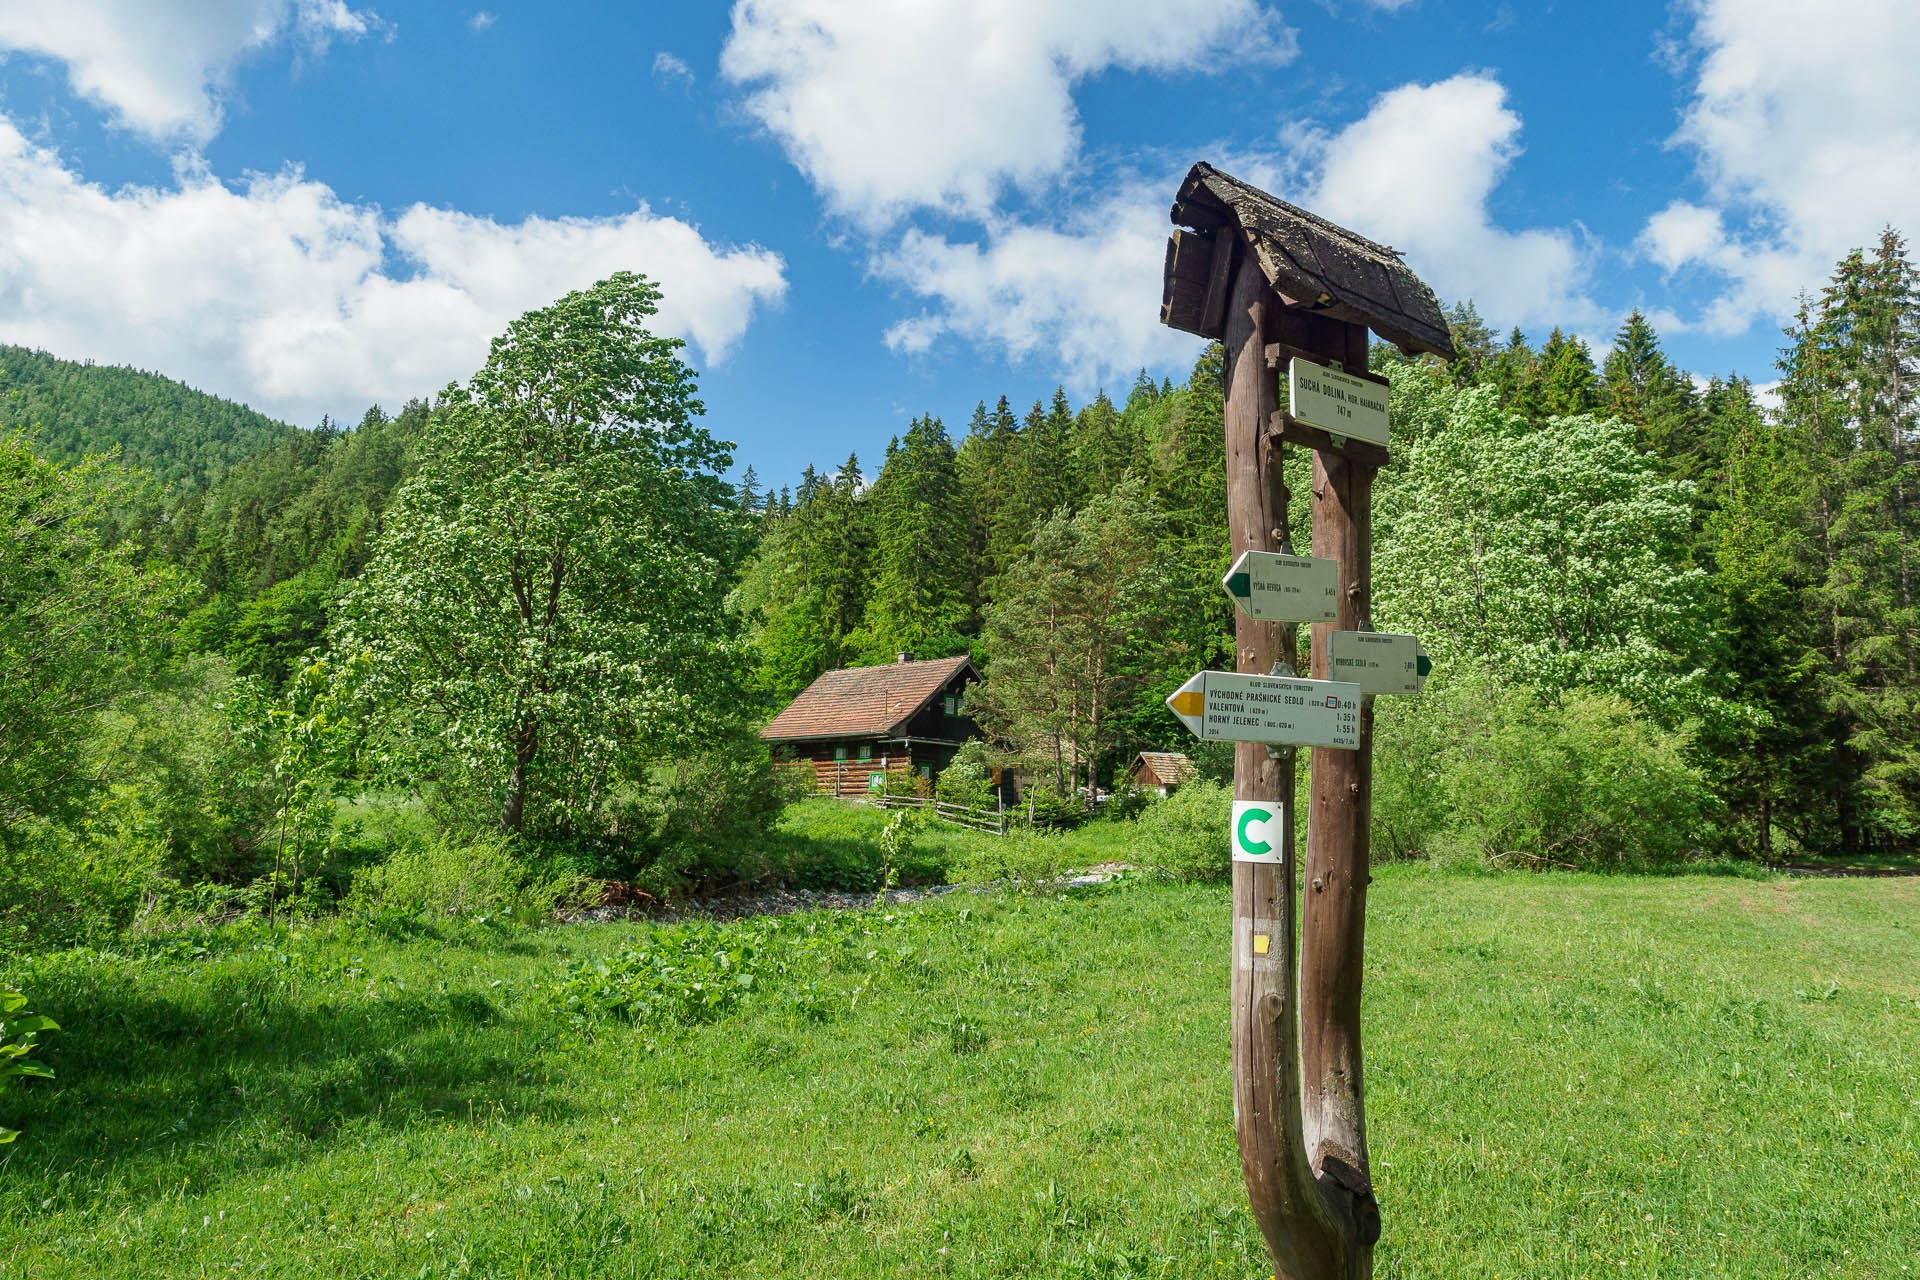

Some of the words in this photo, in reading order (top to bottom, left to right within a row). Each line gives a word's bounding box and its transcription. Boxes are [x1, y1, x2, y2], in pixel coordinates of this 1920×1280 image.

[1323, 384, 1347, 404] DOLINA,
[1336, 405, 1346, 417] 747
[1347, 410, 1352, 418] m
[1263, 682, 1291, 691] SLOVENSKÝCH
[1209, 688, 1243, 700] VÝCHODNÉ
[1246, 691, 1281, 704] PRAŠNICKÉ
[1284, 695, 1304, 706] SEDLO
[1208, 702, 1245, 713] VALENTOVÁ
[1352, 701, 1356, 709] h
[1208, 714, 1231, 724] HORNÝ
[1232, 716, 1260, 727] JELENEC
[1352, 714, 1356, 722] h
[1351, 725, 1355, 734] h
[1237, 808, 1273, 855] C
